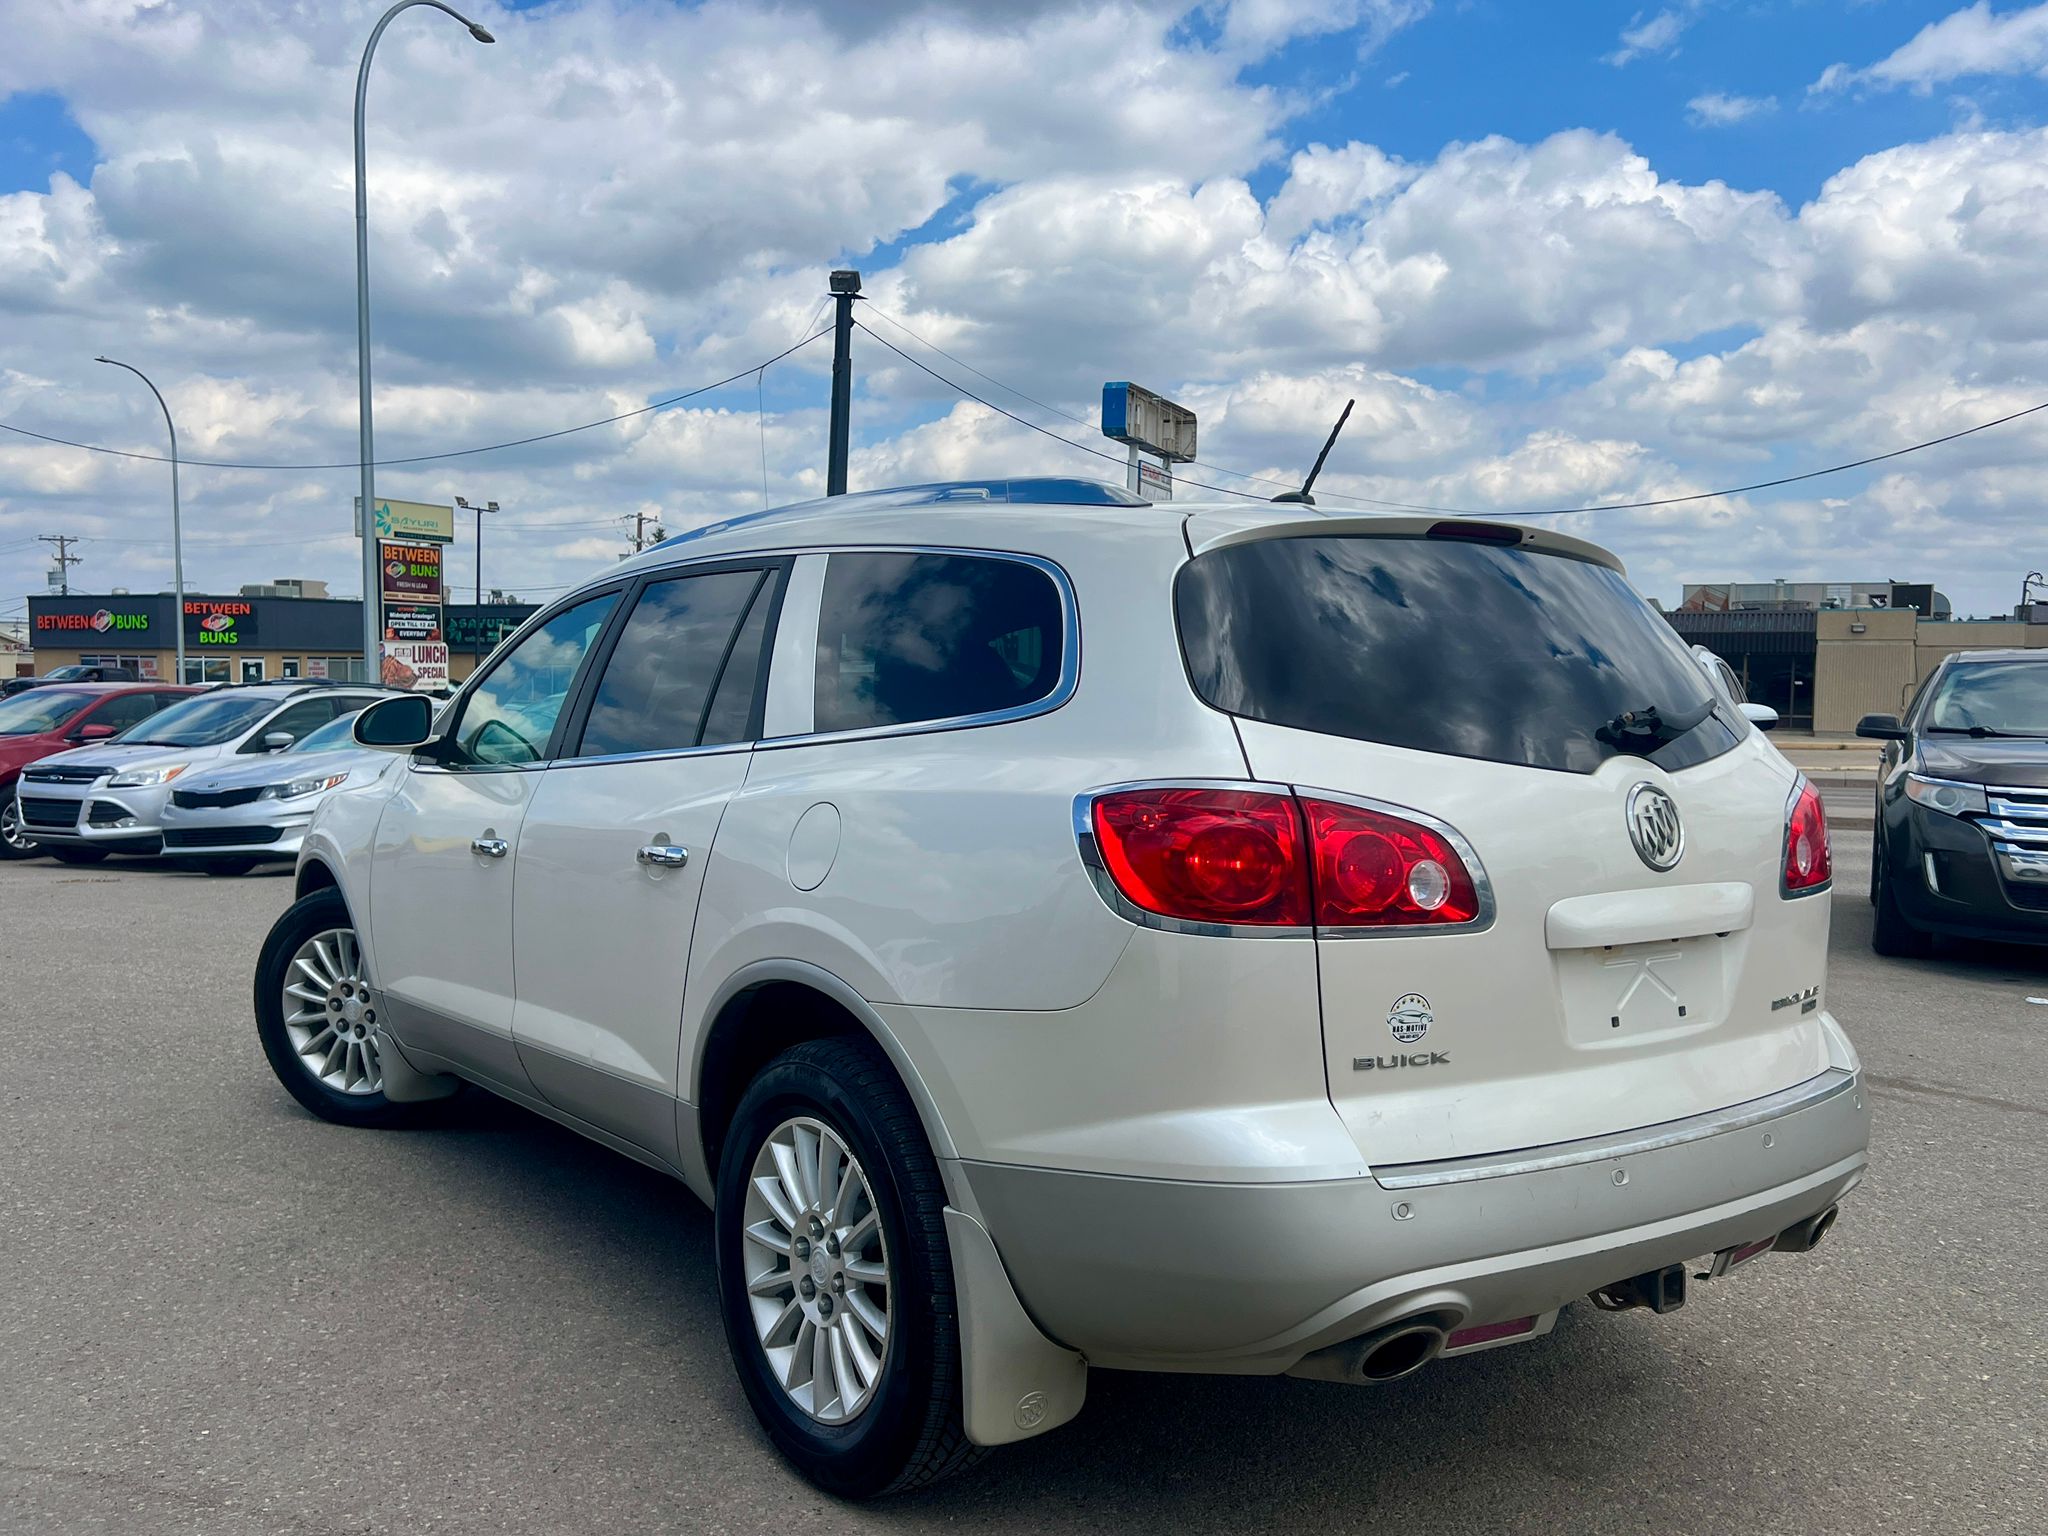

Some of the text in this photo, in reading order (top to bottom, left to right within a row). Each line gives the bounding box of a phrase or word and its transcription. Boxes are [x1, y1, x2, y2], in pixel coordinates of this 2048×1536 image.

[391, 516, 439, 528] SAYURI
[384, 546, 439, 563] BETWEEN
[410, 564, 439, 577] BUNS
[184, 602, 251, 615] BETWEEN
[37, 614, 148, 630] BETWEEN BUNS
[199, 631, 238, 644] BUNS
[412, 645, 447, 664] LUNCH
[418, 667, 447, 679] SPECIAL
[1353, 1050, 1452, 1071] BUICK
